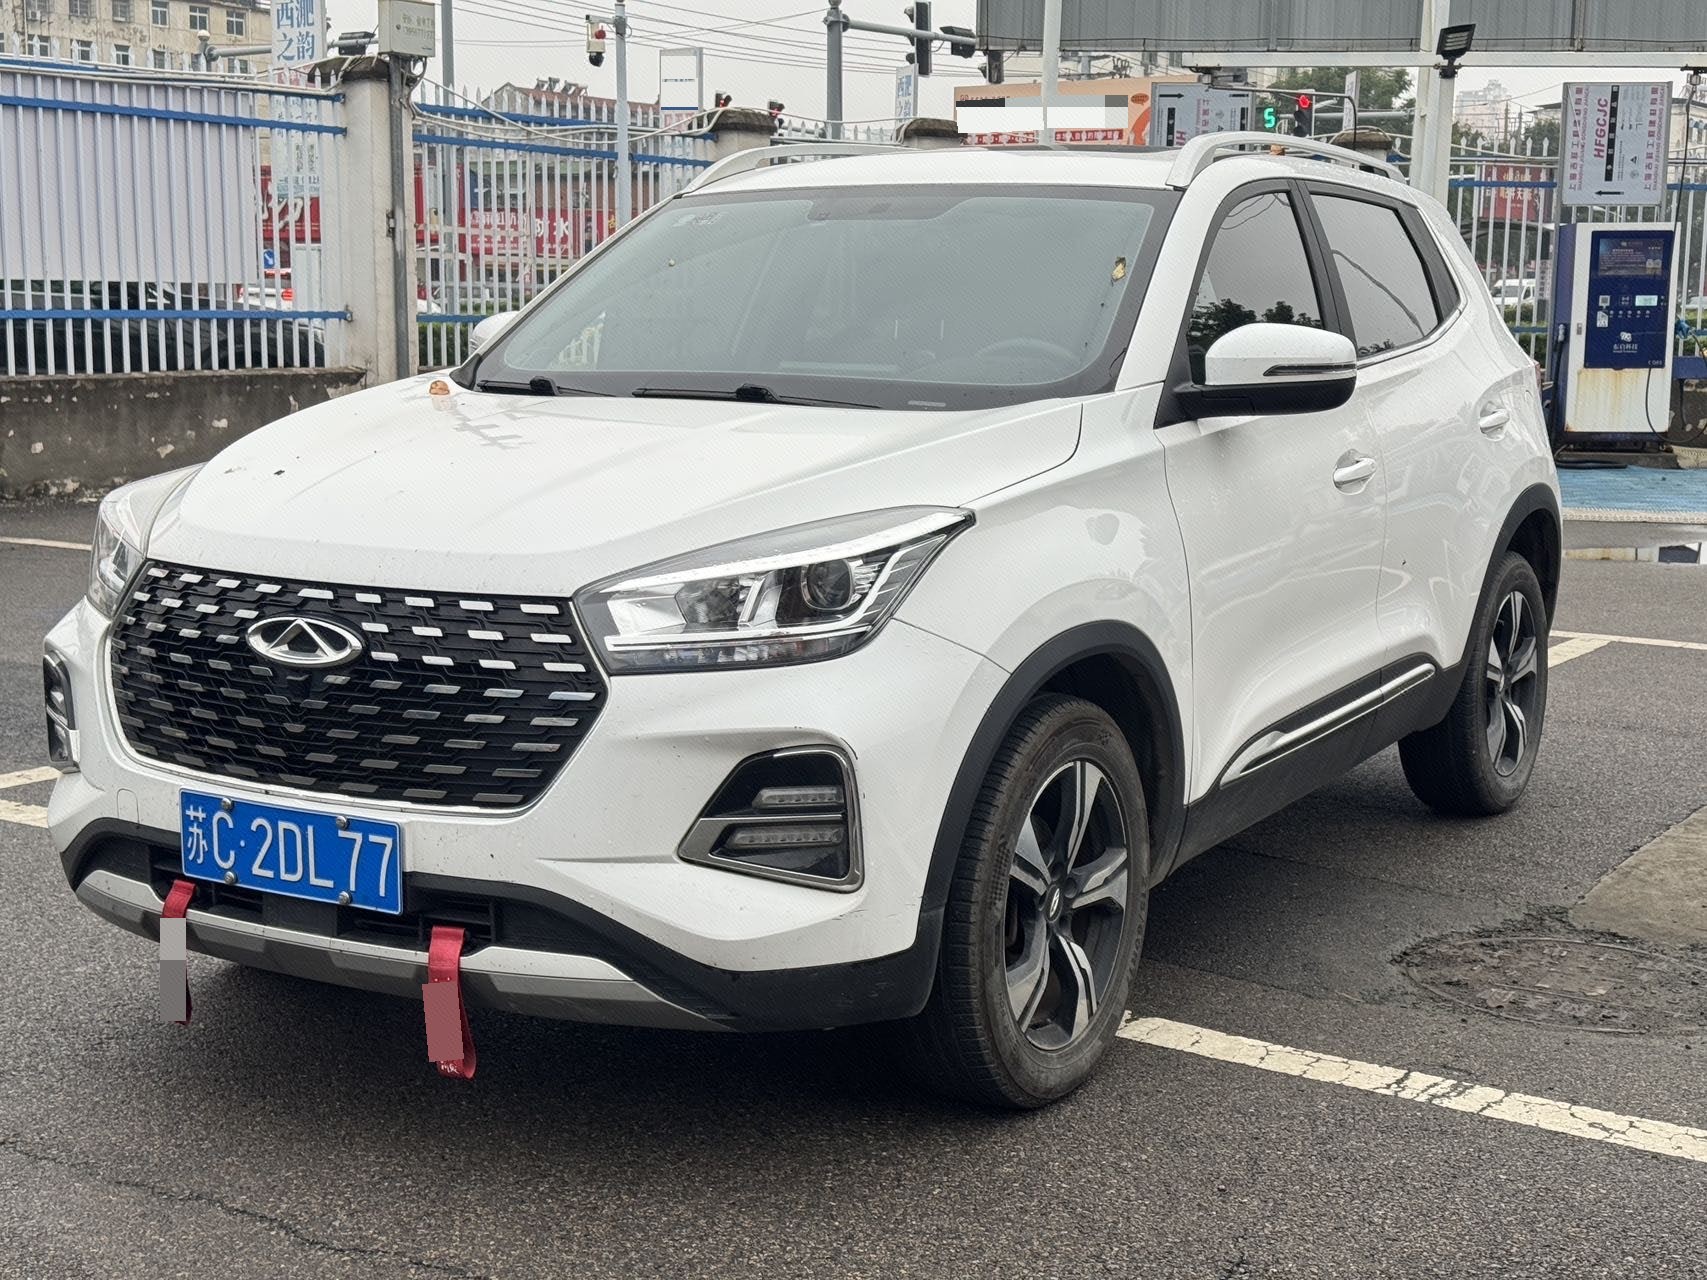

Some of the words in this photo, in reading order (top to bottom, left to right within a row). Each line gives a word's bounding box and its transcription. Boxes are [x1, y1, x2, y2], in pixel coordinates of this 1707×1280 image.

[276, 31, 315, 61] 之韵
[1593, 97, 1609, 159] HFGCJC
[185, 804, 393, 898] 苏C·2DL77
